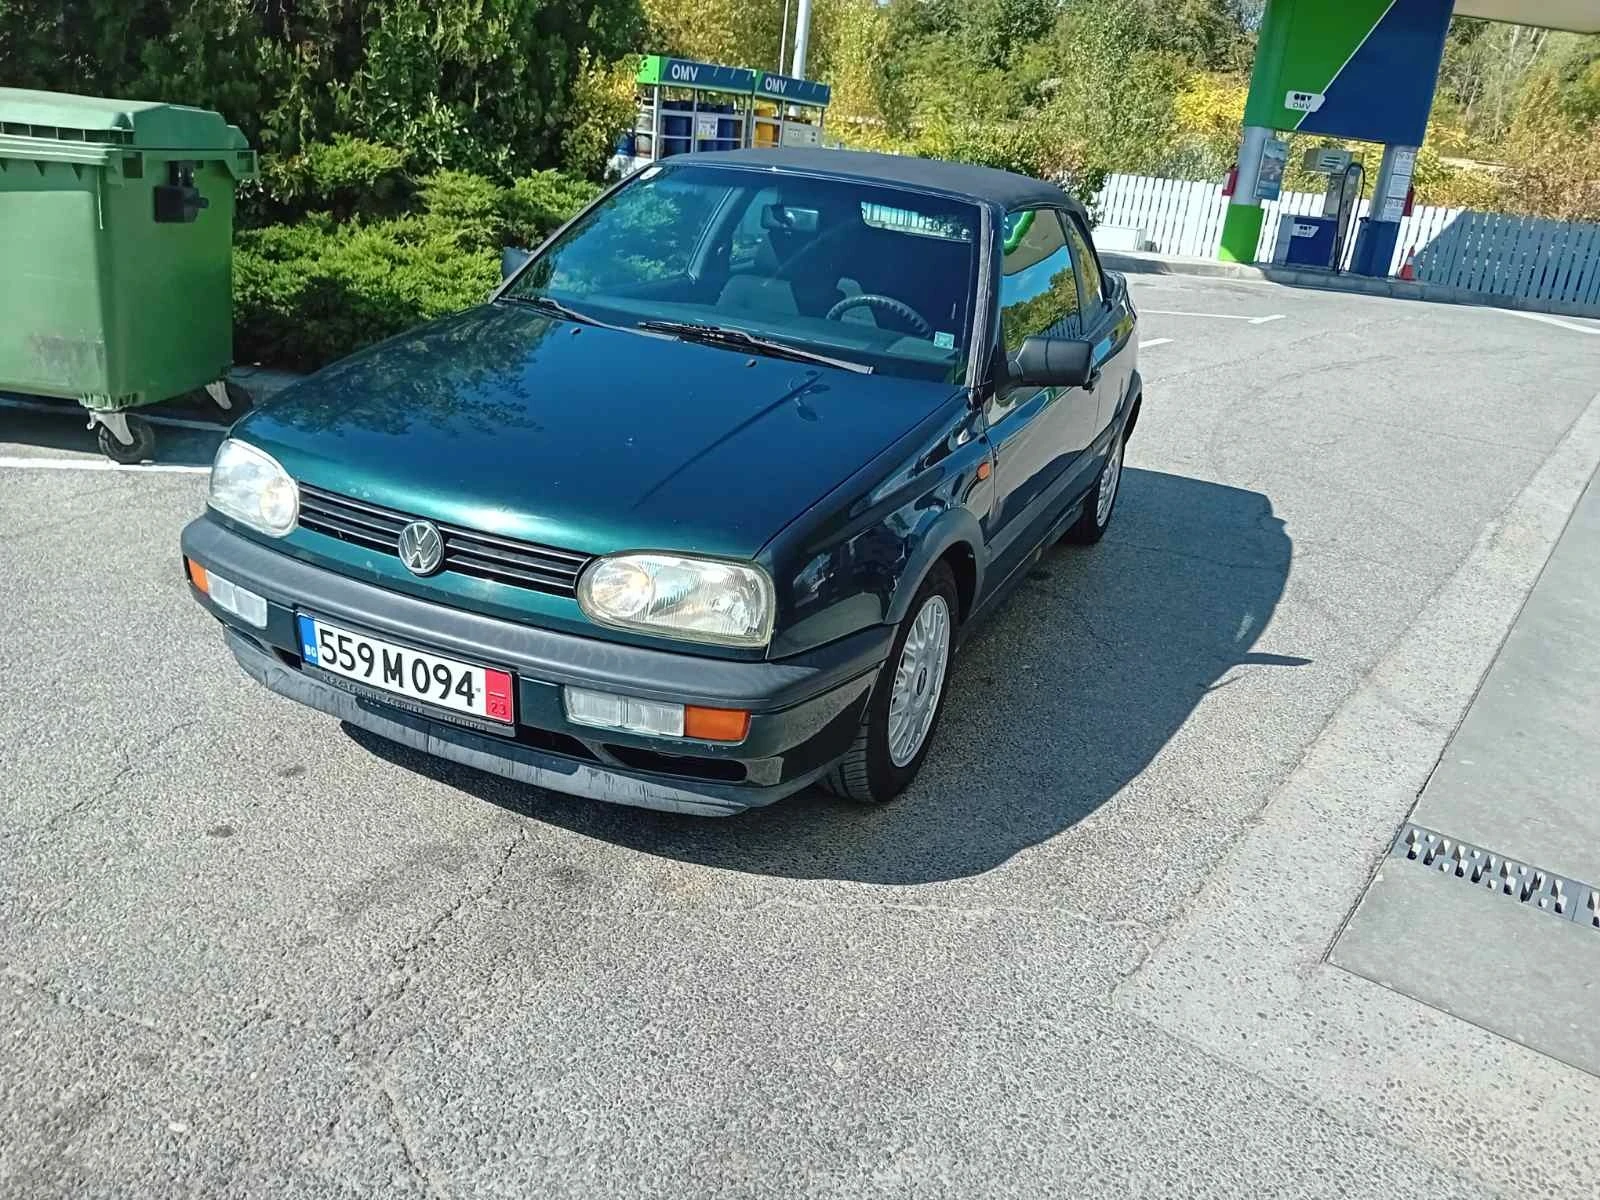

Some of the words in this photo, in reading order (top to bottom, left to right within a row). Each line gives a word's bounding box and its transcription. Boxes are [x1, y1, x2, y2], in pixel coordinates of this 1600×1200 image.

[672, 64, 699, 81] OMV
[765, 77, 787, 93] OMV
[304, 644, 317, 657] BG
[319, 628, 375, 677] 559
[382, 647, 405, 689] M
[411, 658, 475, 707] 094
[490, 702, 507, 716] 23
